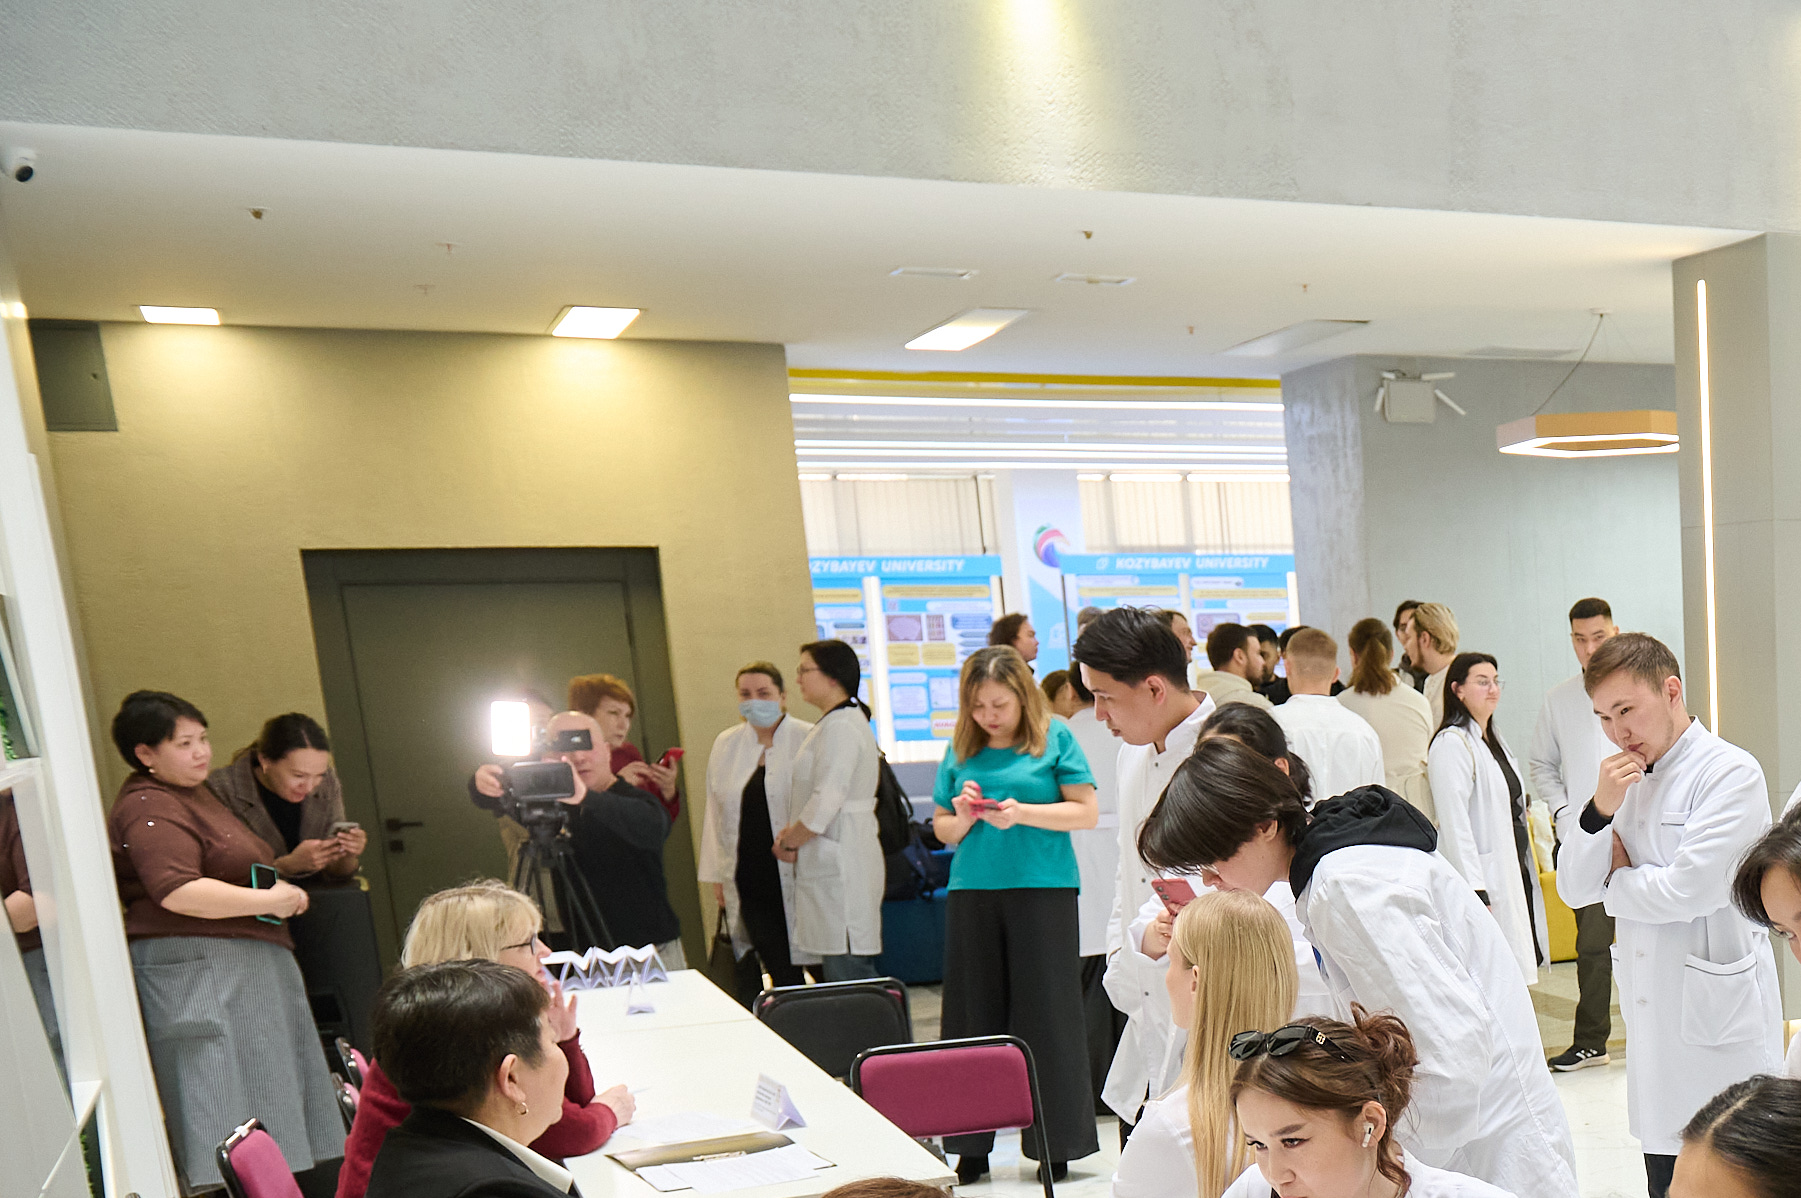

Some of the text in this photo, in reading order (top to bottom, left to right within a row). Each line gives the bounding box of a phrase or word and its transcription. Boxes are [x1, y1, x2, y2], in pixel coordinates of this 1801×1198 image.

[809, 559, 966, 573] ZYBAYEV UNIVERSITY
[1115, 556, 1269, 570] KOZYBAYEV UNIVERSITY
